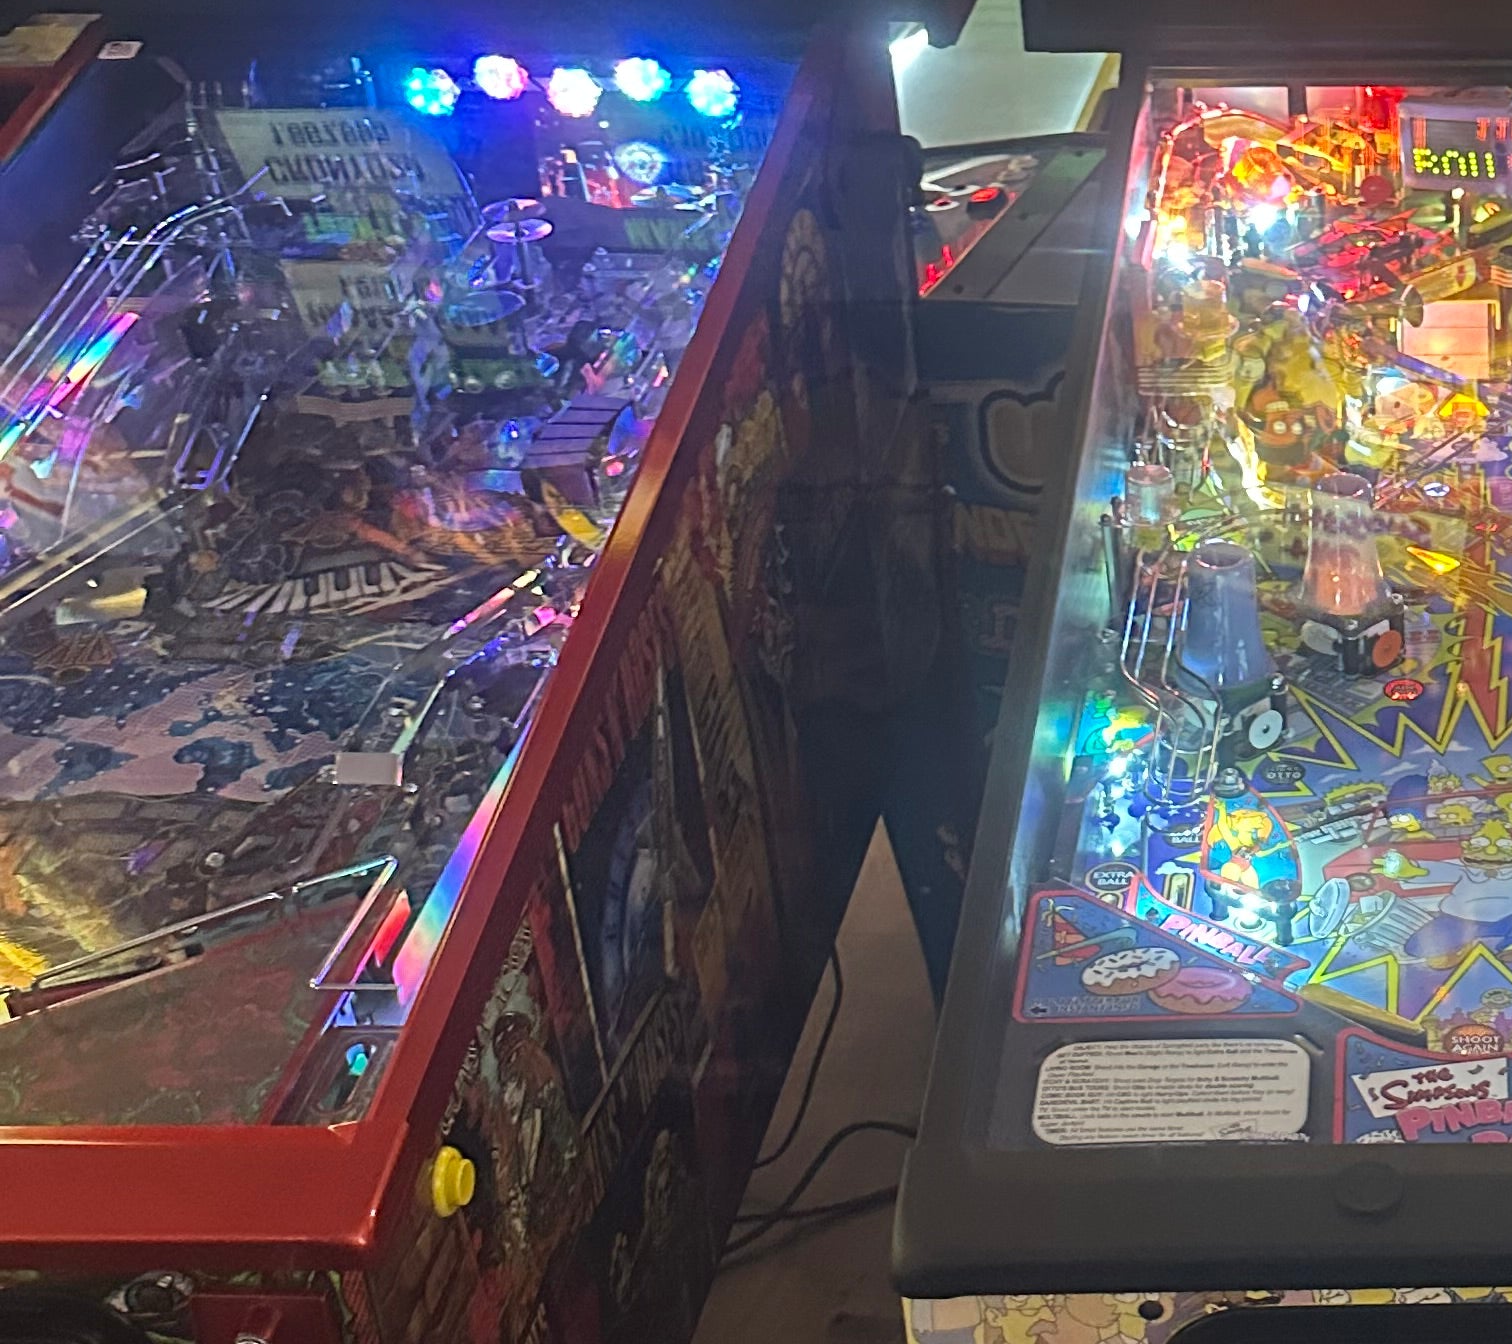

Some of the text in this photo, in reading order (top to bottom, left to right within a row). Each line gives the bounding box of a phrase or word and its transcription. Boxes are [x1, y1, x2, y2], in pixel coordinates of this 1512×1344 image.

[1093, 871, 1135, 879] EXTRA
[1097, 878, 1129, 886] BALL
[1159, 913, 1274, 966] PINBALL
[1450, 1034, 1501, 1045] SHOOT
[1451, 1043, 1499, 1054] AGAIN
